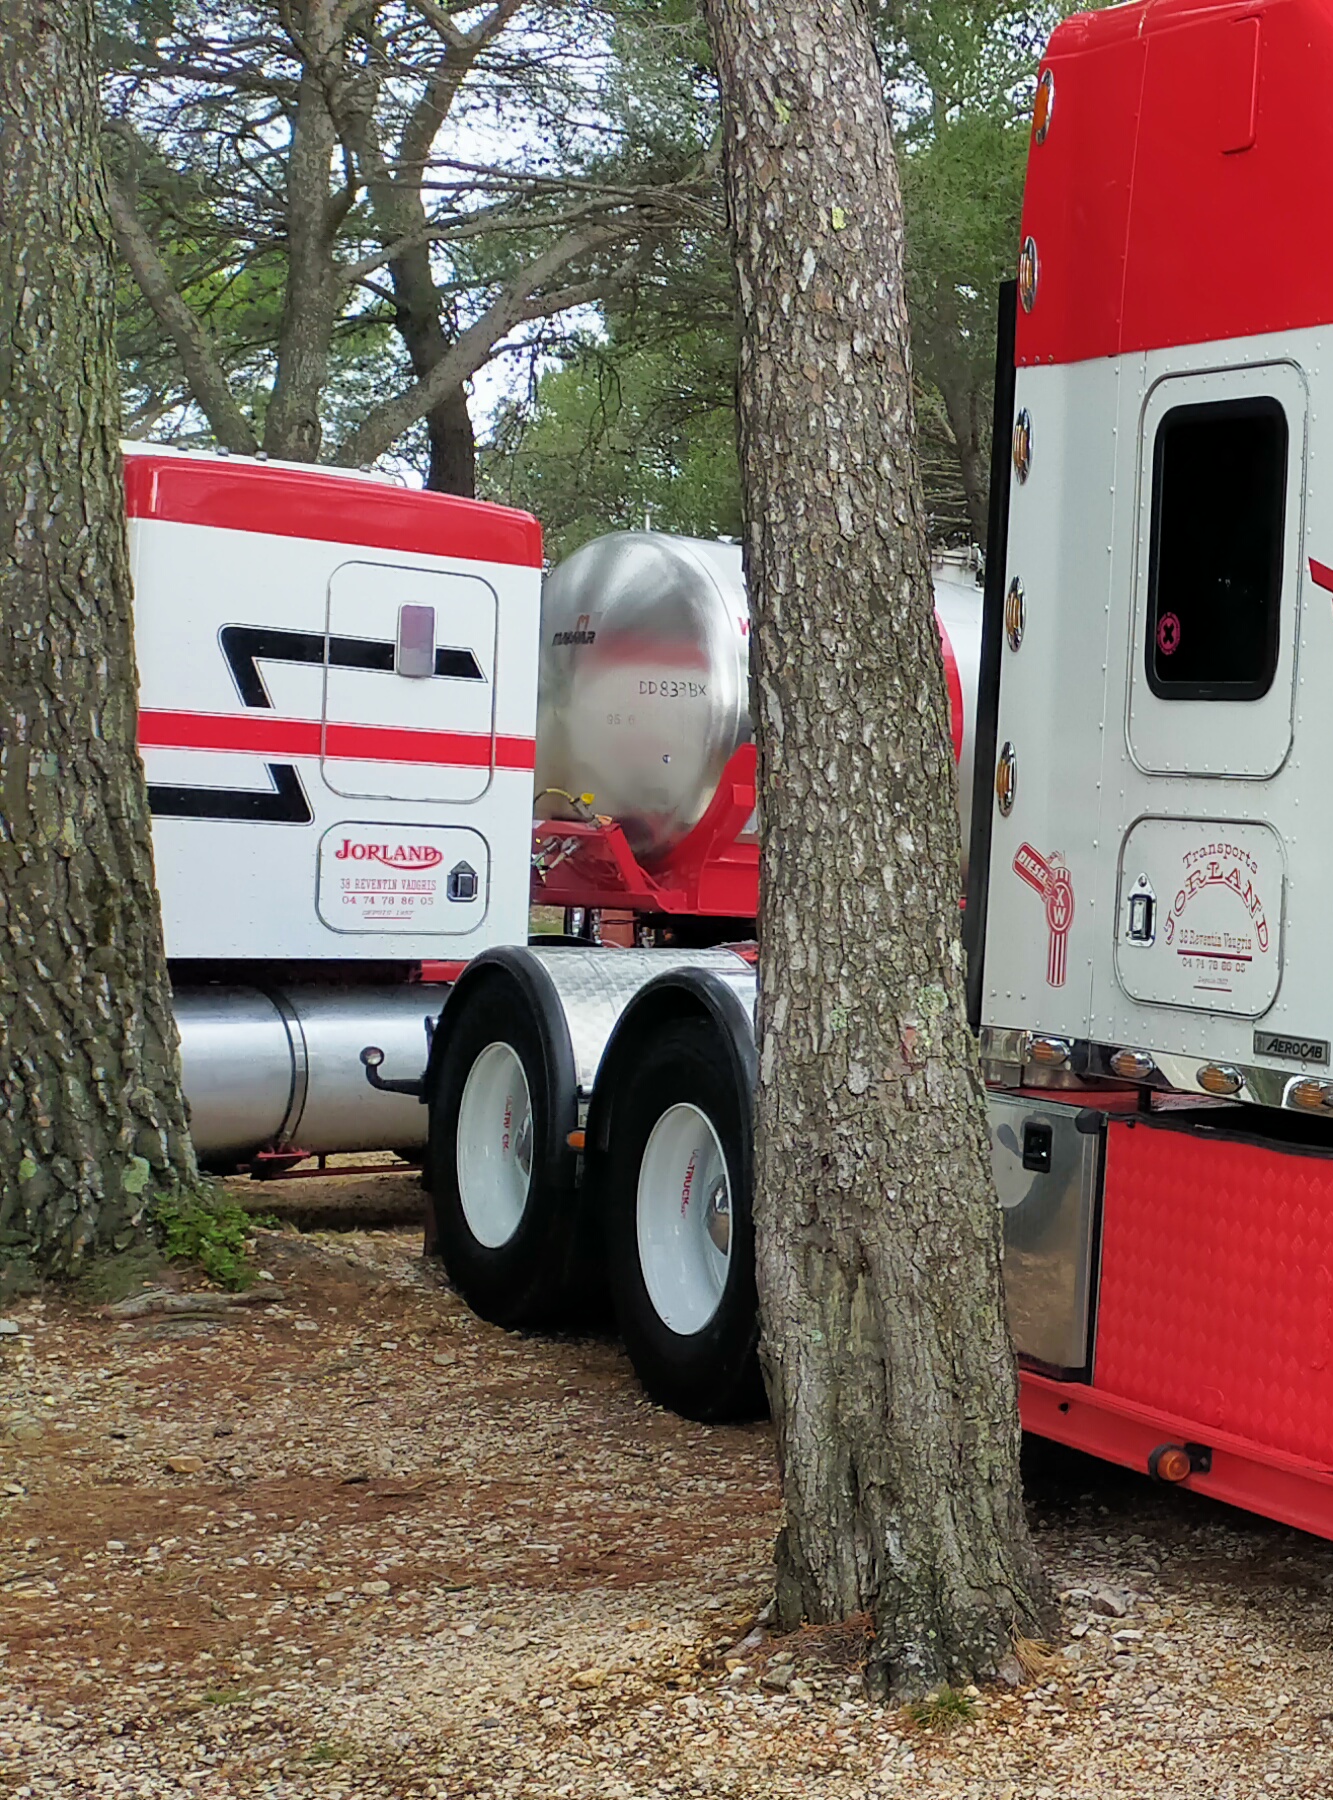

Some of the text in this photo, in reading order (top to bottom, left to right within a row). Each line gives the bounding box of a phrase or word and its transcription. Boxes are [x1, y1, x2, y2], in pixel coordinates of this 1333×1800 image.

[335, 839, 444, 870] JORLAND
[1017, 850, 1048, 886] DIESEL
[1183, 843, 1258, 874] Transports
[342, 896, 357, 905] 04
[1164, 862, 1269, 952] JORLAND
